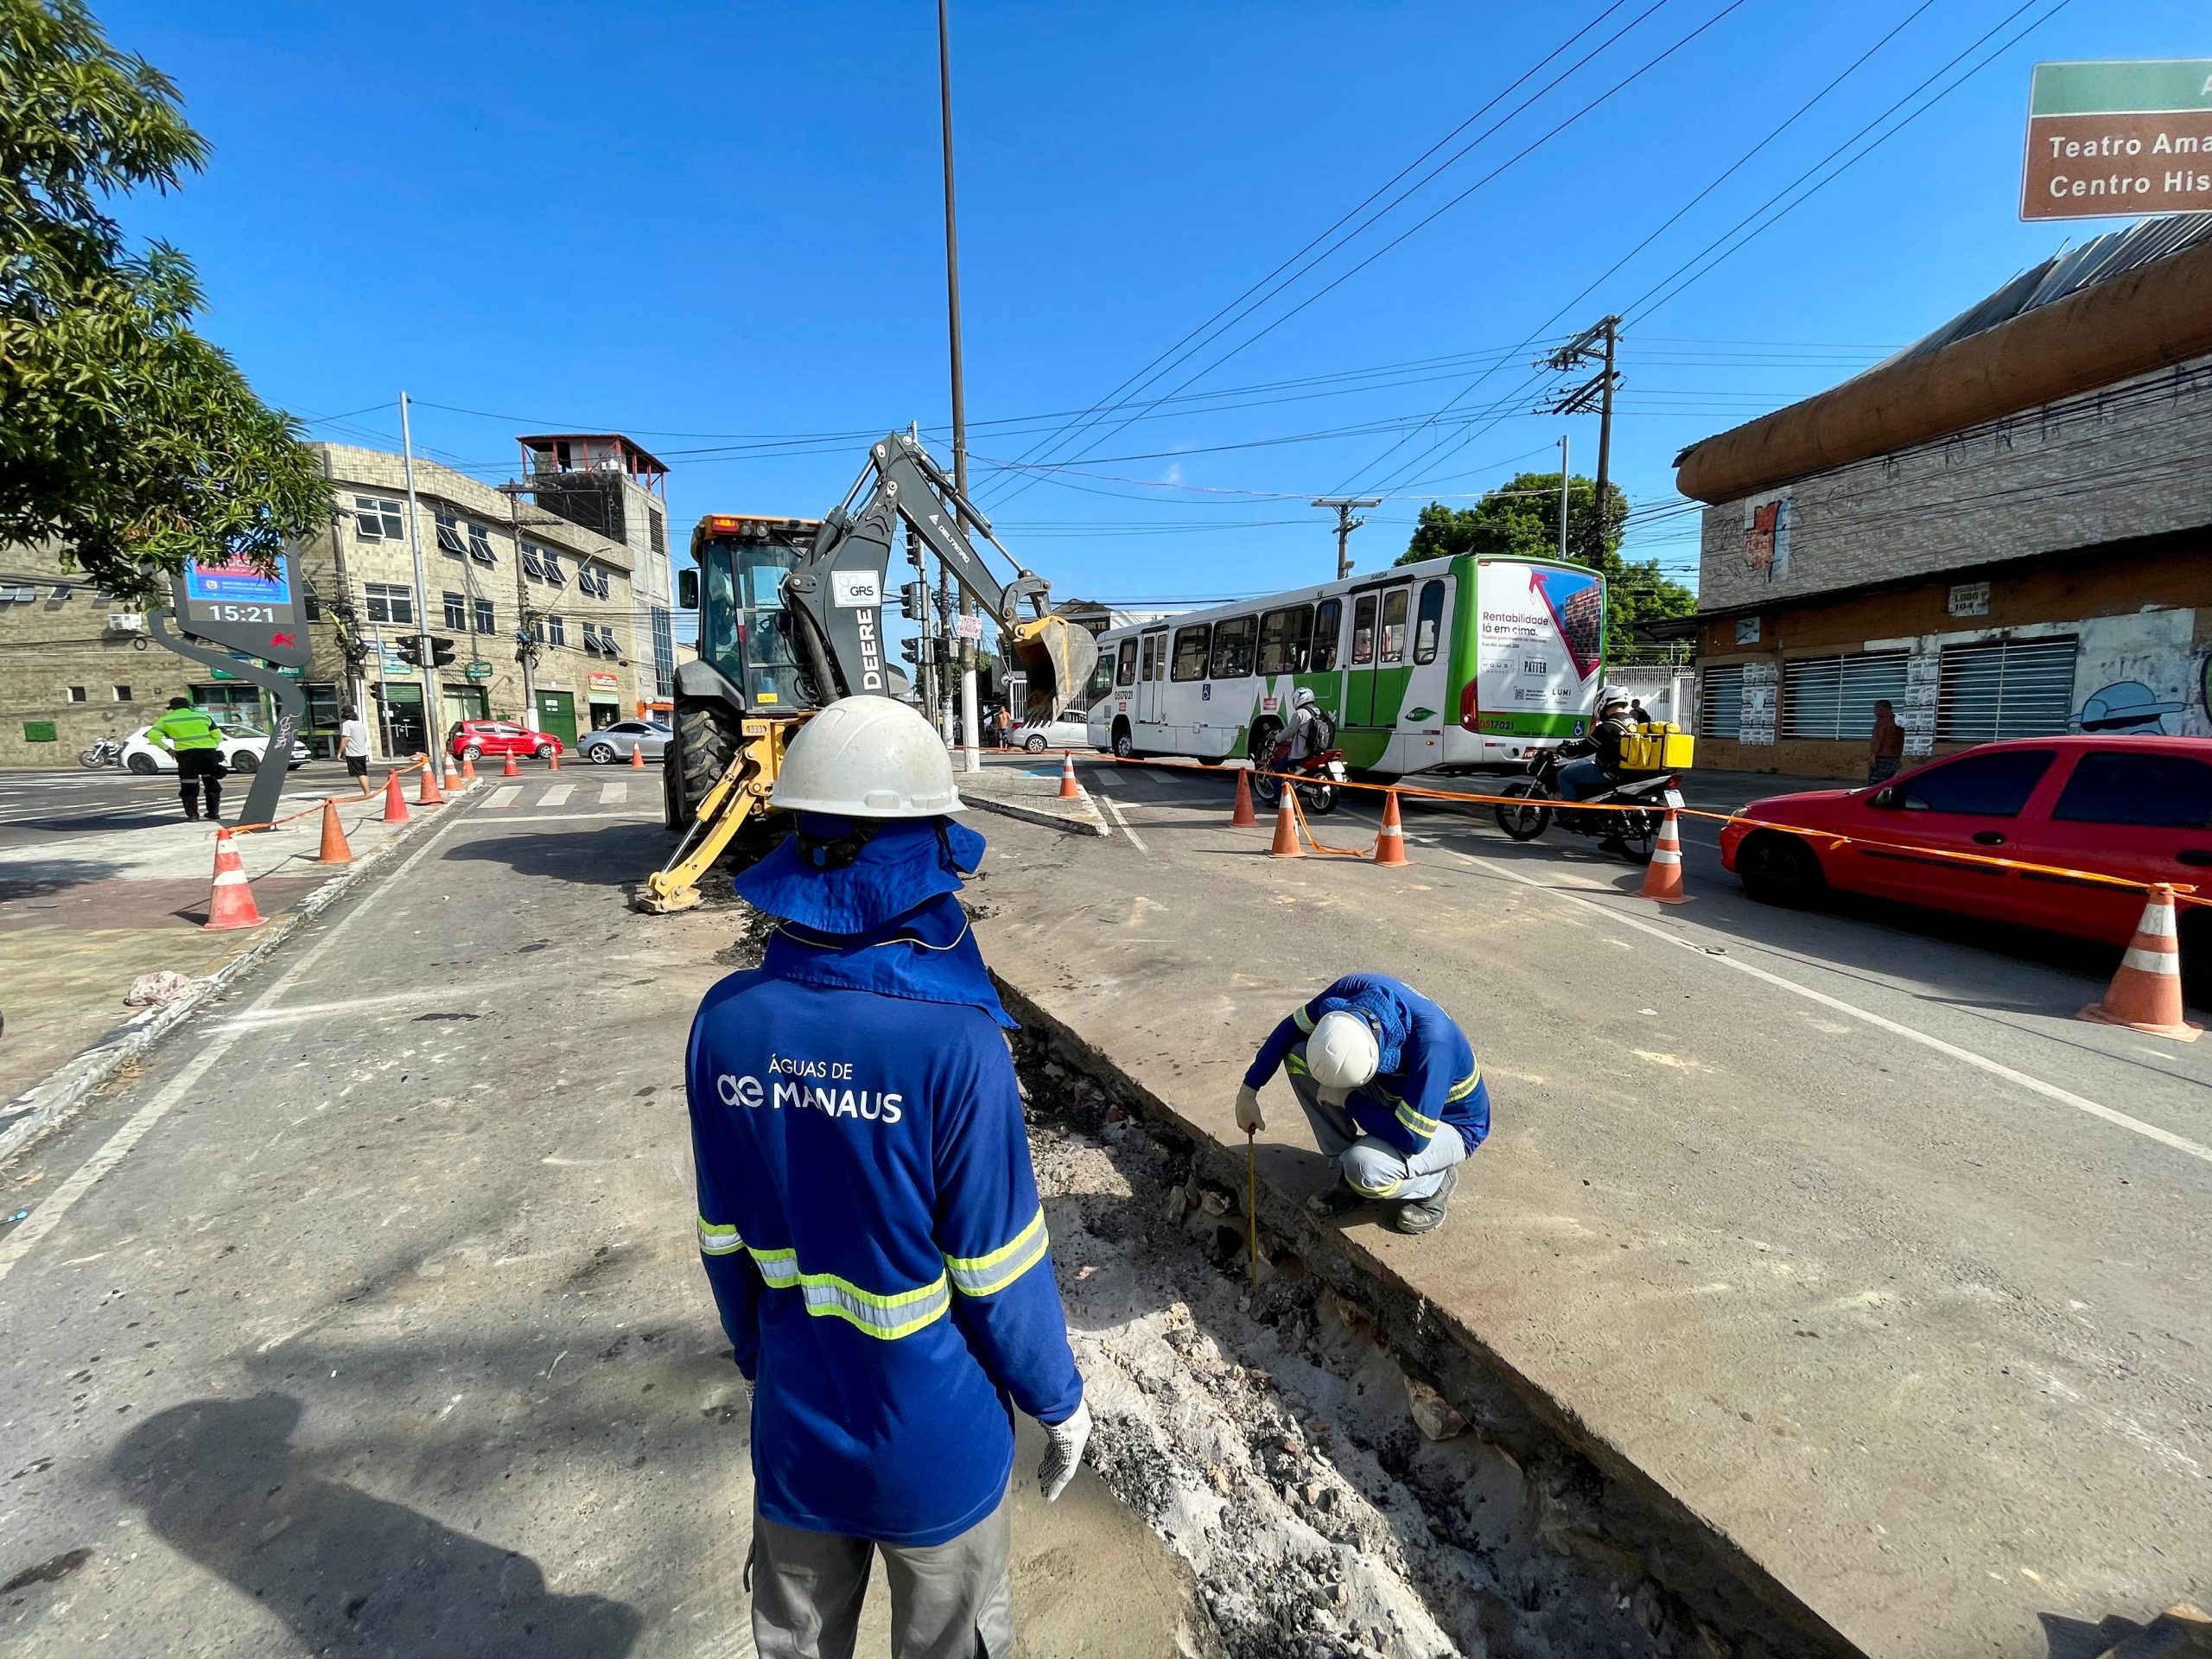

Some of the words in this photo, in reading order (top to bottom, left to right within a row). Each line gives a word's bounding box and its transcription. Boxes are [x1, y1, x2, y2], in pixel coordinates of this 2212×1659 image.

[2049, 135, 2142, 158] Teatro
[2152, 132, 2212, 156] Ama
[2050, 174, 2152, 198] Centro
[2164, 170, 2211, 193] His
[849, 586, 874, 597] GRS
[209, 605, 275, 623] 15:21
[1483, 612, 1548, 626] Rentabilidade
[1483, 623, 1492, 633] lá
[1512, 626, 1539, 637] cima.
[856, 608, 882, 690] DEERE
[1524, 660, 1547, 674] PATTER
[1552, 688, 1572, 696] LUMI
[768, 1053, 827, 1078] ÁGUAS
[831, 1063, 854, 1080] DE
[773, 1083, 903, 1124] MANAUS
